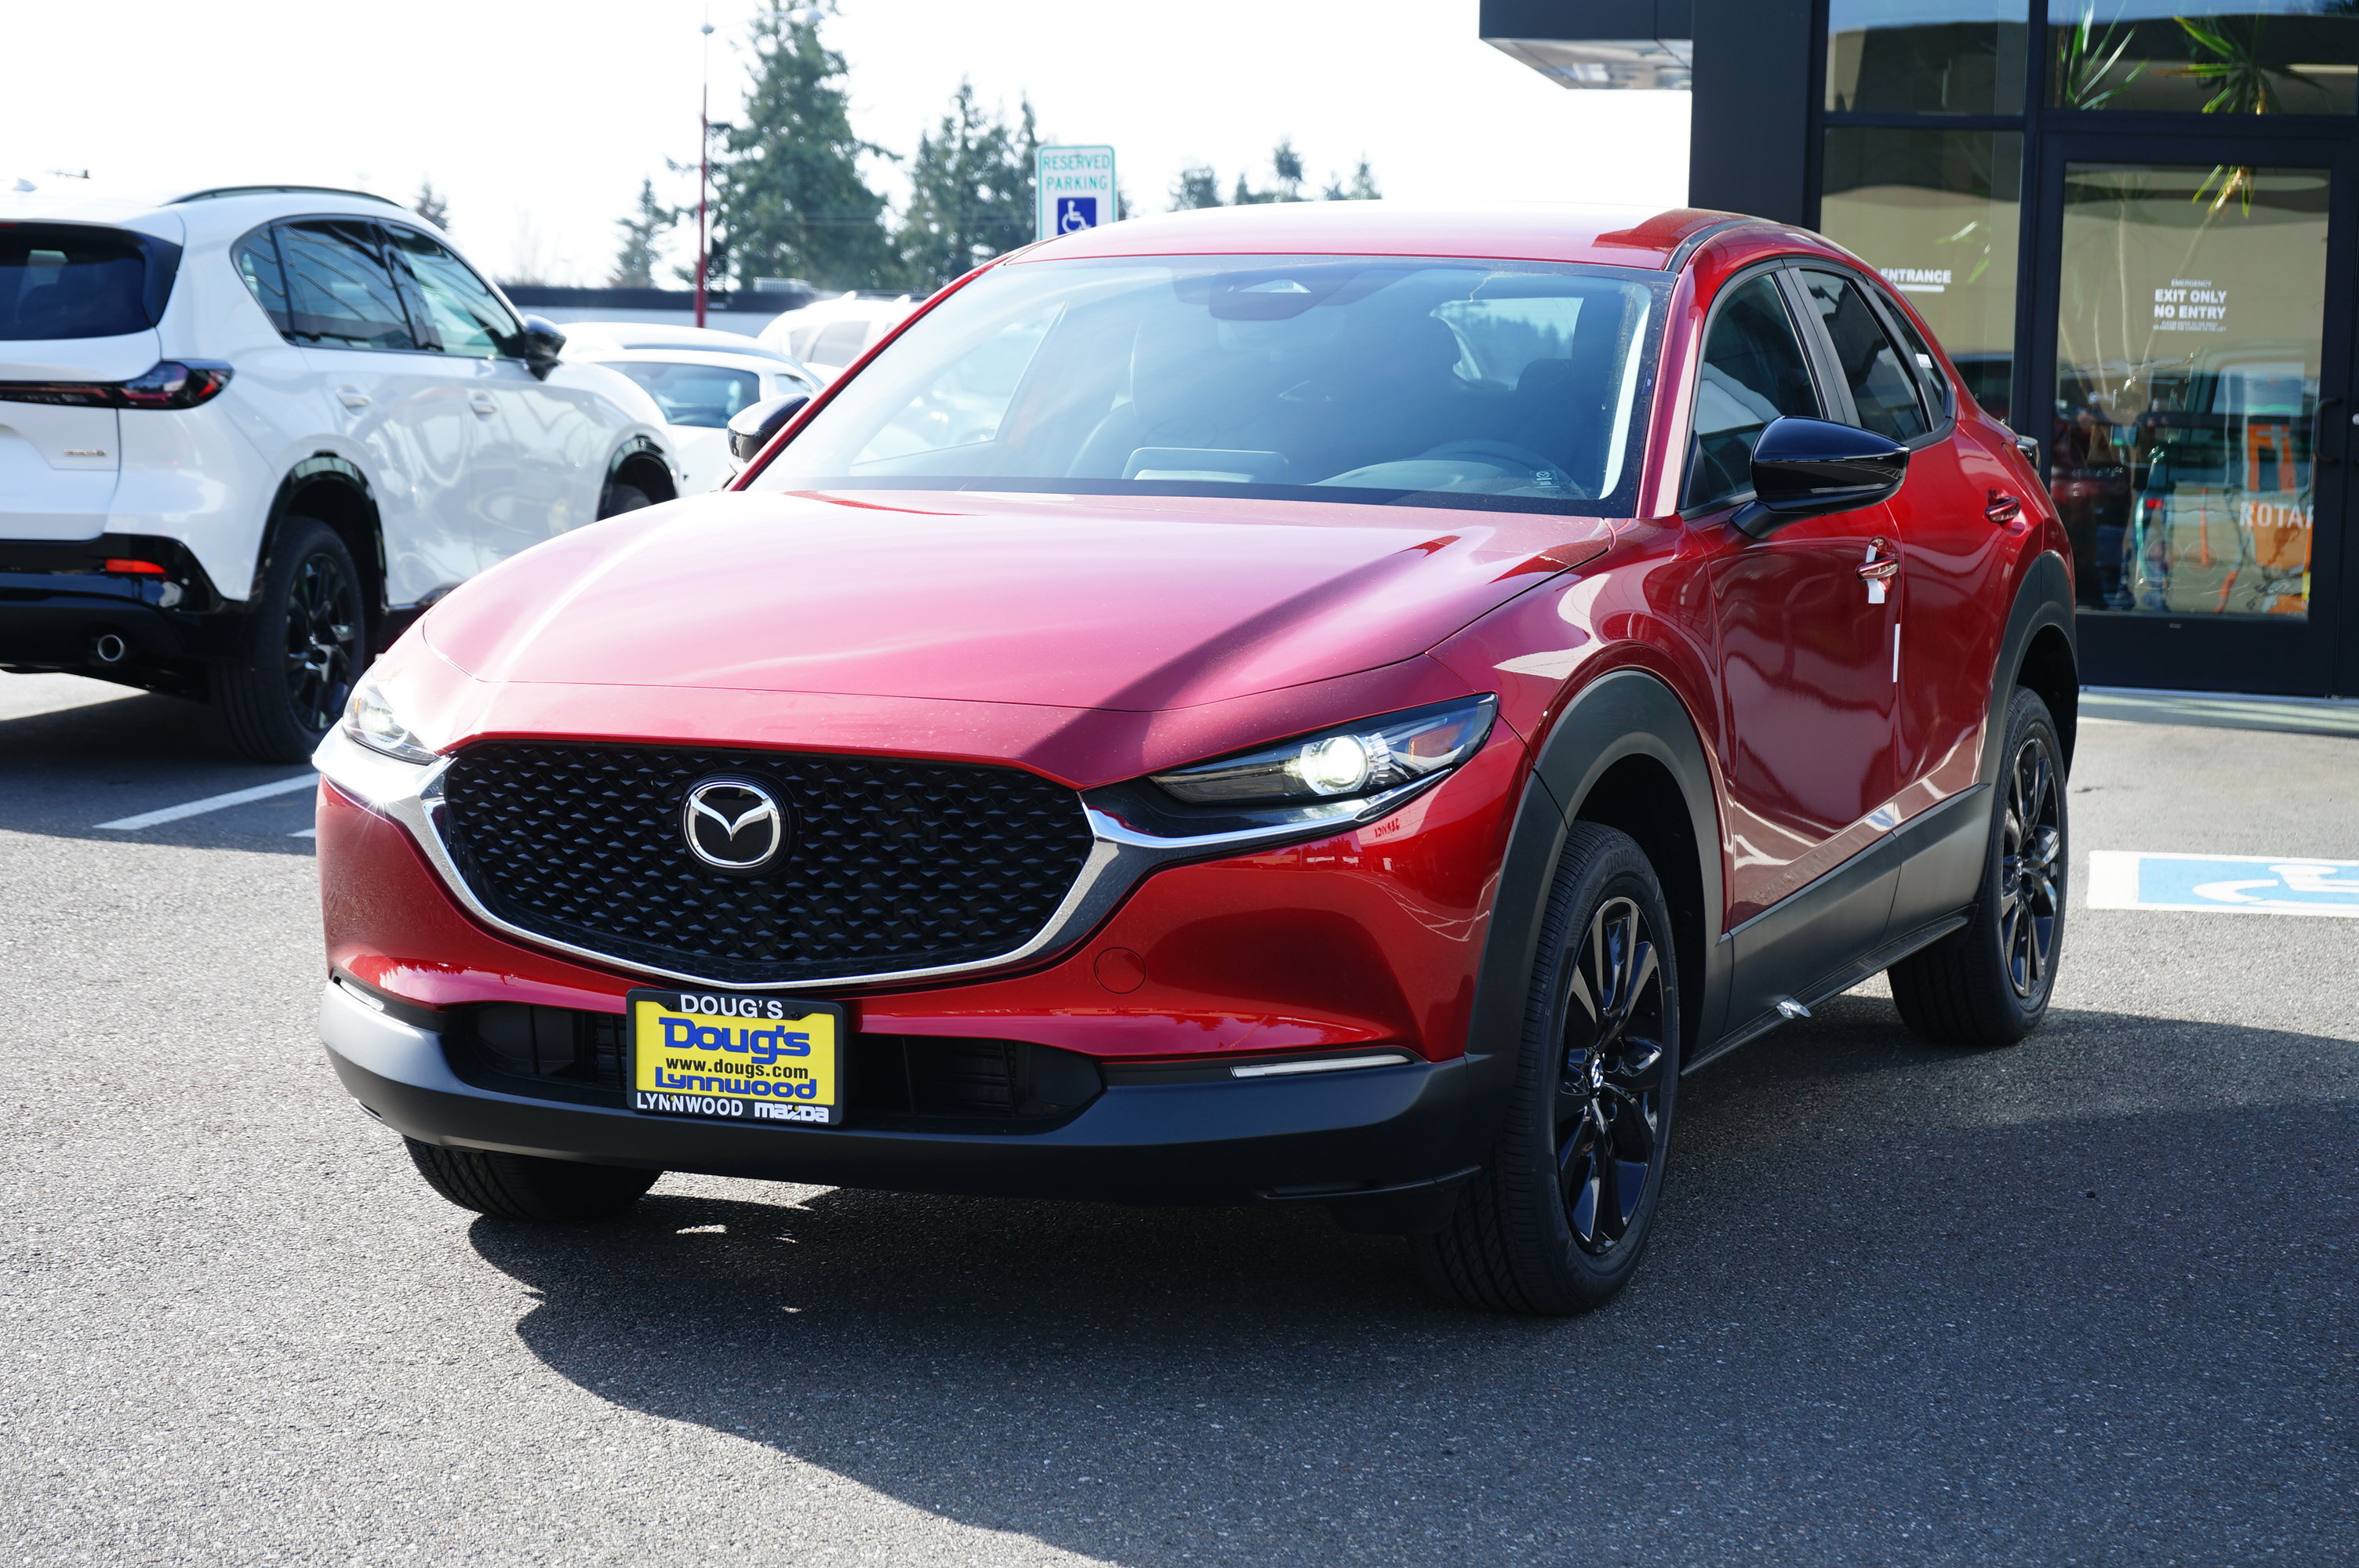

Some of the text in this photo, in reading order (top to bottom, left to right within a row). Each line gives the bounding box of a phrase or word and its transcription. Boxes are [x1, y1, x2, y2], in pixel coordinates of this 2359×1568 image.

[1043, 154, 1110, 171] RESERVED
[1046, 175, 1107, 191] PARKING
[1881, 268, 1952, 283] ENTRANCE
[2154, 289, 2227, 303] EXIT ONLY
[2154, 304, 2226, 320] NO ENTRY
[680, 993, 783, 1019] DOUG'S
[658, 1016, 811, 1065] Doug's
[666, 1058, 809, 1079] www.dougs.com
[655, 1066, 817, 1099] Lynnwood
[636, 1092, 743, 1116] LYNNWOOD
